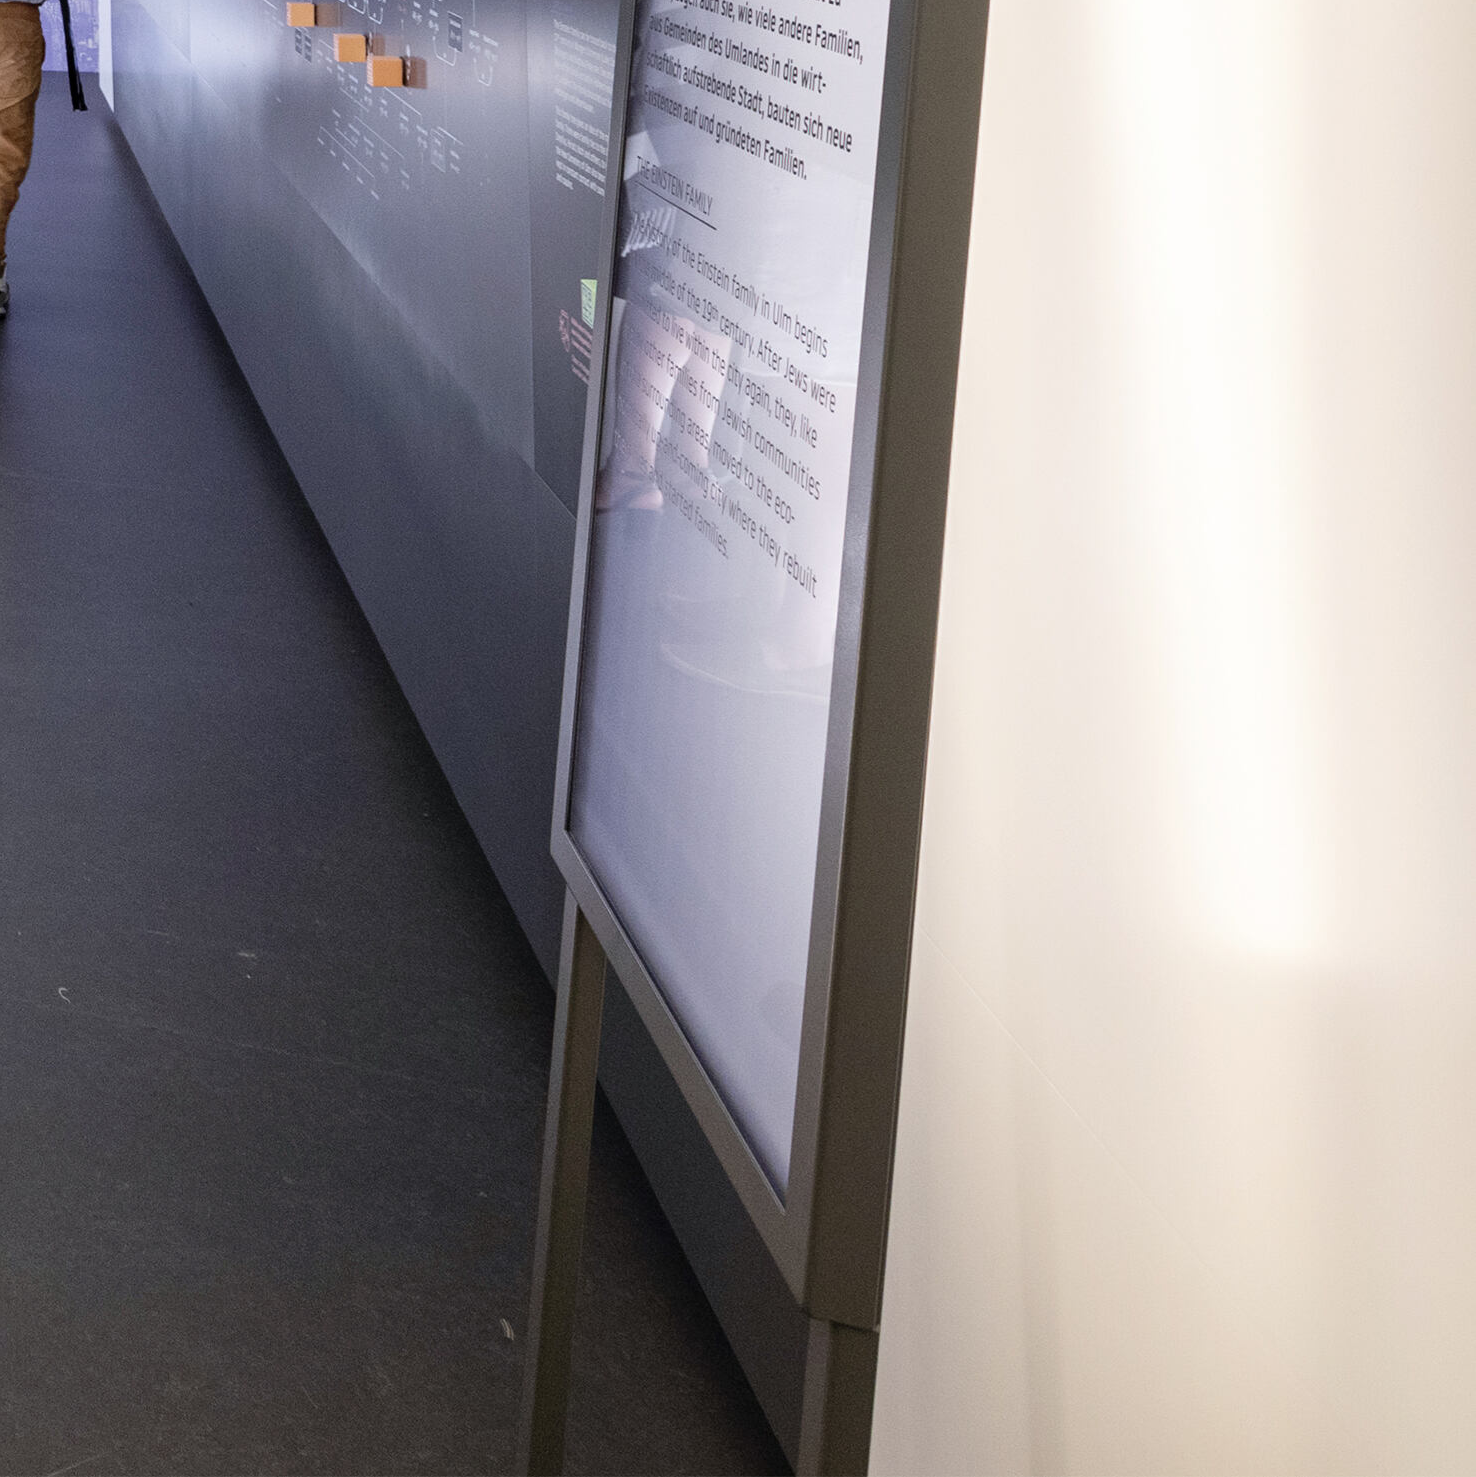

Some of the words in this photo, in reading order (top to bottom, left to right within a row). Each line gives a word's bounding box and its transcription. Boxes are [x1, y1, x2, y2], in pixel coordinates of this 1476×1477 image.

[648, 16, 662, 34] aus
[663, 17, 706, 50] Gemeinden
[708, 32, 722, 56] des
[725, 39, 768, 73] Umlandes
[771, 53, 780, 77] in
[783, 57, 797, 84] die
[801, 66, 826, 93] wirt-
[737, 2, 753, 25] wie
[755, 7, 775, 32] viele
[777, 16, 811, 44] andere
[815, 26, 863, 65] Familien,
[643, 84, 682, 119] Existenzen
[683, 106, 698, 127] auf
[699, 113, 715, 135] und
[716, 120, 761, 157] gründeten
[764, 140, 807, 181] Familien.
[645, 50, 681, 79] schaftlich
[682, 65, 735, 102] aufstrebende
[737, 85, 764, 119] Stadt,
[767, 96, 800, 130] bauten
[803, 113, 822, 140] sich
[825, 126, 852, 152] neue
[637, 156, 650, 182] THE
[651, 164, 683, 201] EINSTEIN
[685, 183, 712, 217] FAMILY
[677, 282, 687, 303] of
[687, 287, 700, 313] the
[720, 314, 754, 357] century.
[757, 337, 782, 373] After
[784, 356, 808, 392] Jews
[810, 379, 836, 412] were
[682, 240, 695, 265] the
[697, 250, 729, 289] Einstein
[731, 272, 759, 317] family
[762, 292, 769, 317] in
[773, 301, 791, 332] Ulm
[794, 314, 827, 357] begins
[670, 317, 683, 345] live
[685, 333, 709, 365] within
[711, 350, 725, 377] the
[727, 364, 744, 398] city
[745, 379, 772, 418] again,
[774, 398, 797, 438] they,
[800, 415, 816, 449] like
[699, 379, 719, 413] from
[721, 398, 751, 441] Jewish
[755, 430, 820, 499] communities
[712, 442, 741, 480] moved
[744, 466, 752, 490] to
[756, 476, 772, 507] the
[774, 495, 794, 524] eco-
[710, 482, 727, 518] city
[729, 501, 756, 540] where
[758, 525, 781, 570] they
[783, 552, 817, 599] rebuilt
